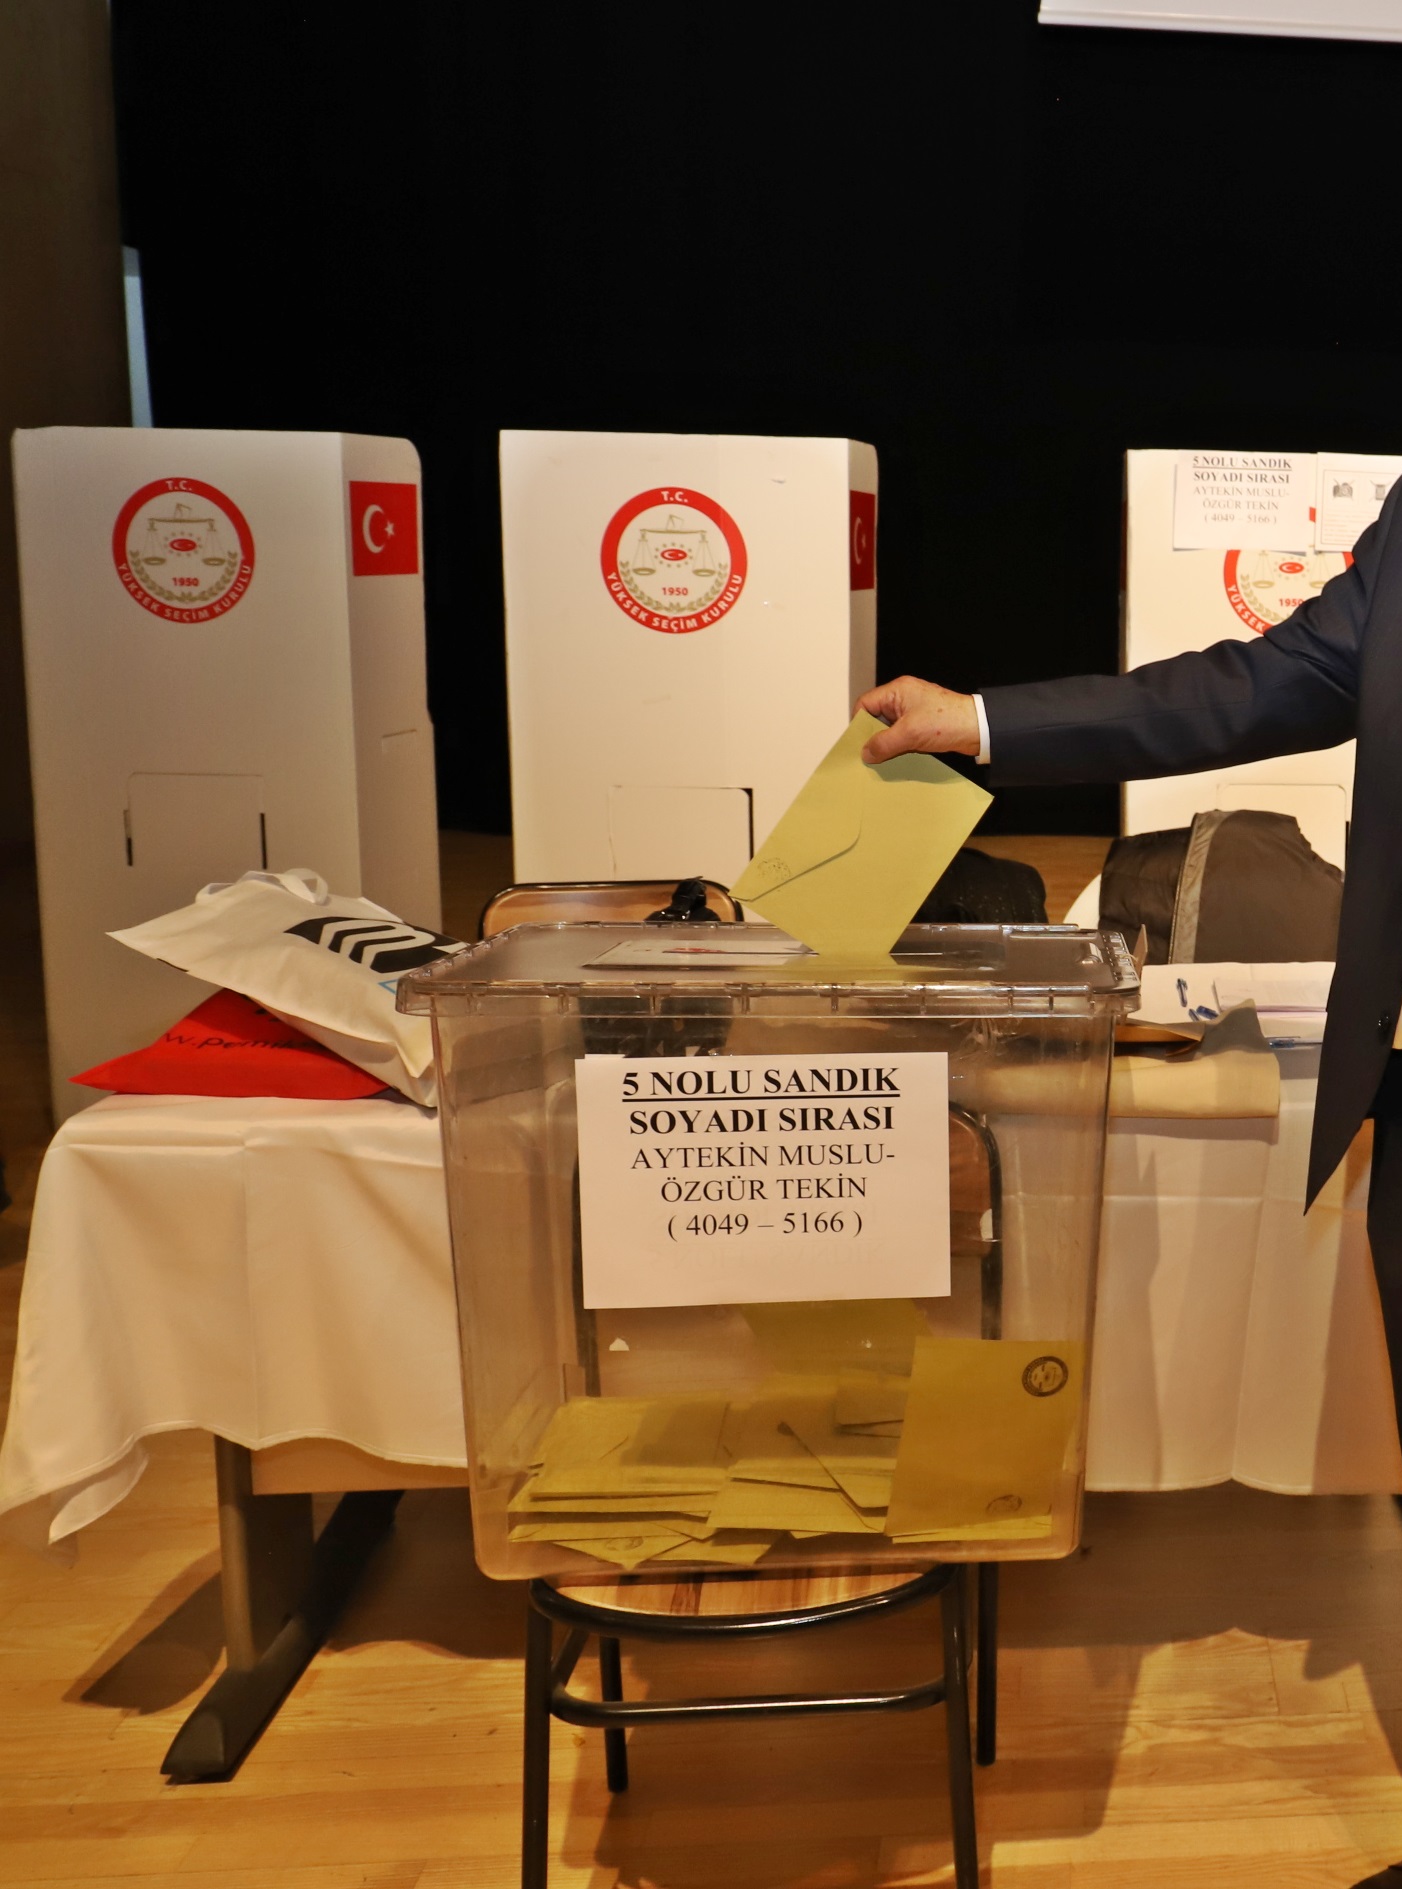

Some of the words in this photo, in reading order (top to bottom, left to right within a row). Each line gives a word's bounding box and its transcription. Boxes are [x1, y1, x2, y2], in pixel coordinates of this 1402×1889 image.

[1193, 456, 1199, 466] 5
[1203, 456, 1237, 467] NOLU
[1242, 458, 1292, 469] SANDIK
[1194, 471, 1243, 482] SOYADI
[1247, 473, 1290, 484] SIRASI
[166, 480, 192, 491] T.C.
[1193, 485, 1243, 496] AYTEKİN
[661, 491, 688, 503] T.C.
[1202, 498, 1242, 509] ÖZGÜR
[1246, 500, 1279, 510] TEKİN
[1211, 513, 1235, 522] 4049
[1247, 515, 1271, 523] 5166
[172, 577, 199, 587] 1950
[118, 563, 161, 612] YÜKSEK
[165, 609, 210, 622] SEÇİM
[213, 565, 251, 614] KURULU
[662, 587, 689, 596] 1950
[607, 572, 649, 622] YÜKSEK
[652, 617, 698, 633] SEÇİM
[701, 574, 743, 623] KURULU
[1227, 584, 1265, 631] YÜKSEK
[622, 1072, 639, 1096] 5
[650, 1070, 752, 1096] NOLU
[763, 1067, 900, 1094] SANDIK
[630, 1108, 768, 1135] SOYADI
[778, 1106, 895, 1132] SIRASI
[631, 1141, 769, 1169] AYTEKİN
[778, 1143, 896, 1167] MUSLU-
[661, 1175, 768, 1202] ÖZGÜR
[776, 1173, 867, 1199] TEKİN
[686, 1213, 750, 1236] 4049
[783, 1211, 845, 1234] 5166
